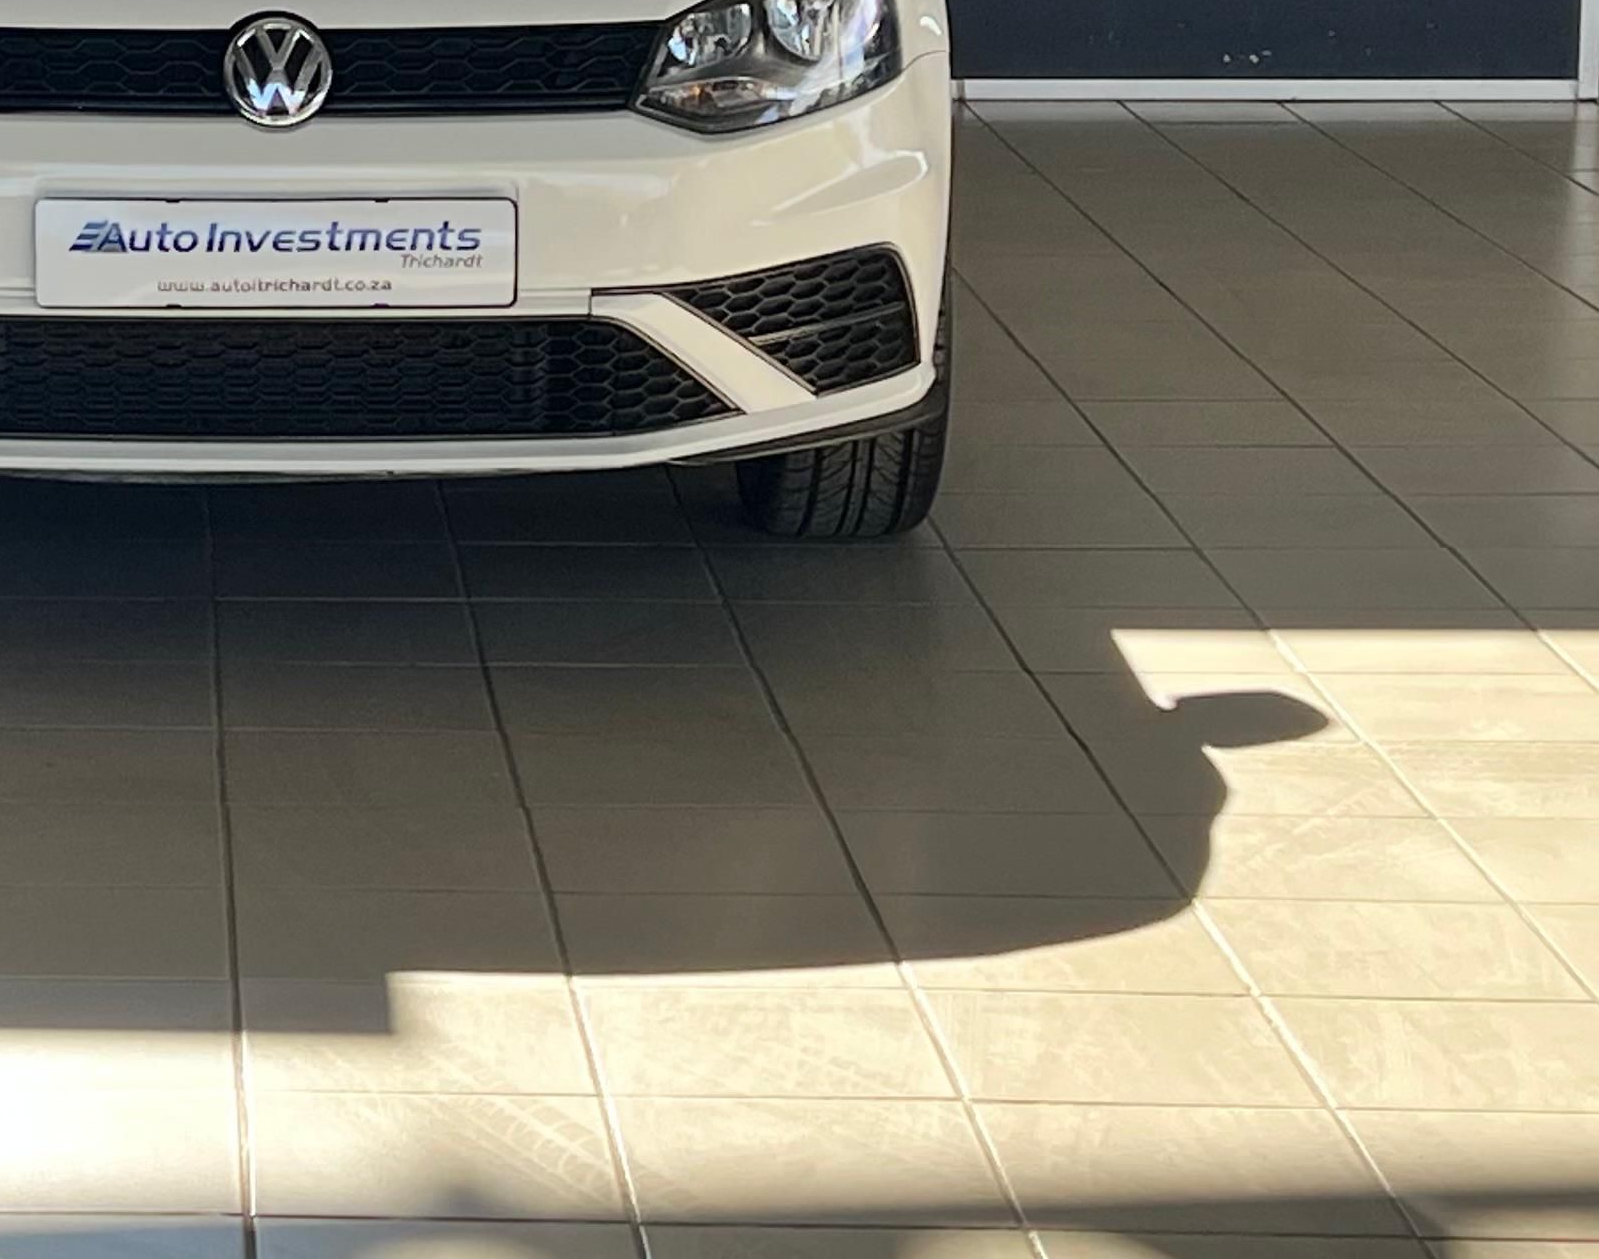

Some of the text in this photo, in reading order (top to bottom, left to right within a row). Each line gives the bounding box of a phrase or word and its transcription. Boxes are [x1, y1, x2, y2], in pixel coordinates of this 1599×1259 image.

[99, 220, 482, 254] Auto Investments
[400, 252, 484, 269] Trichardt
